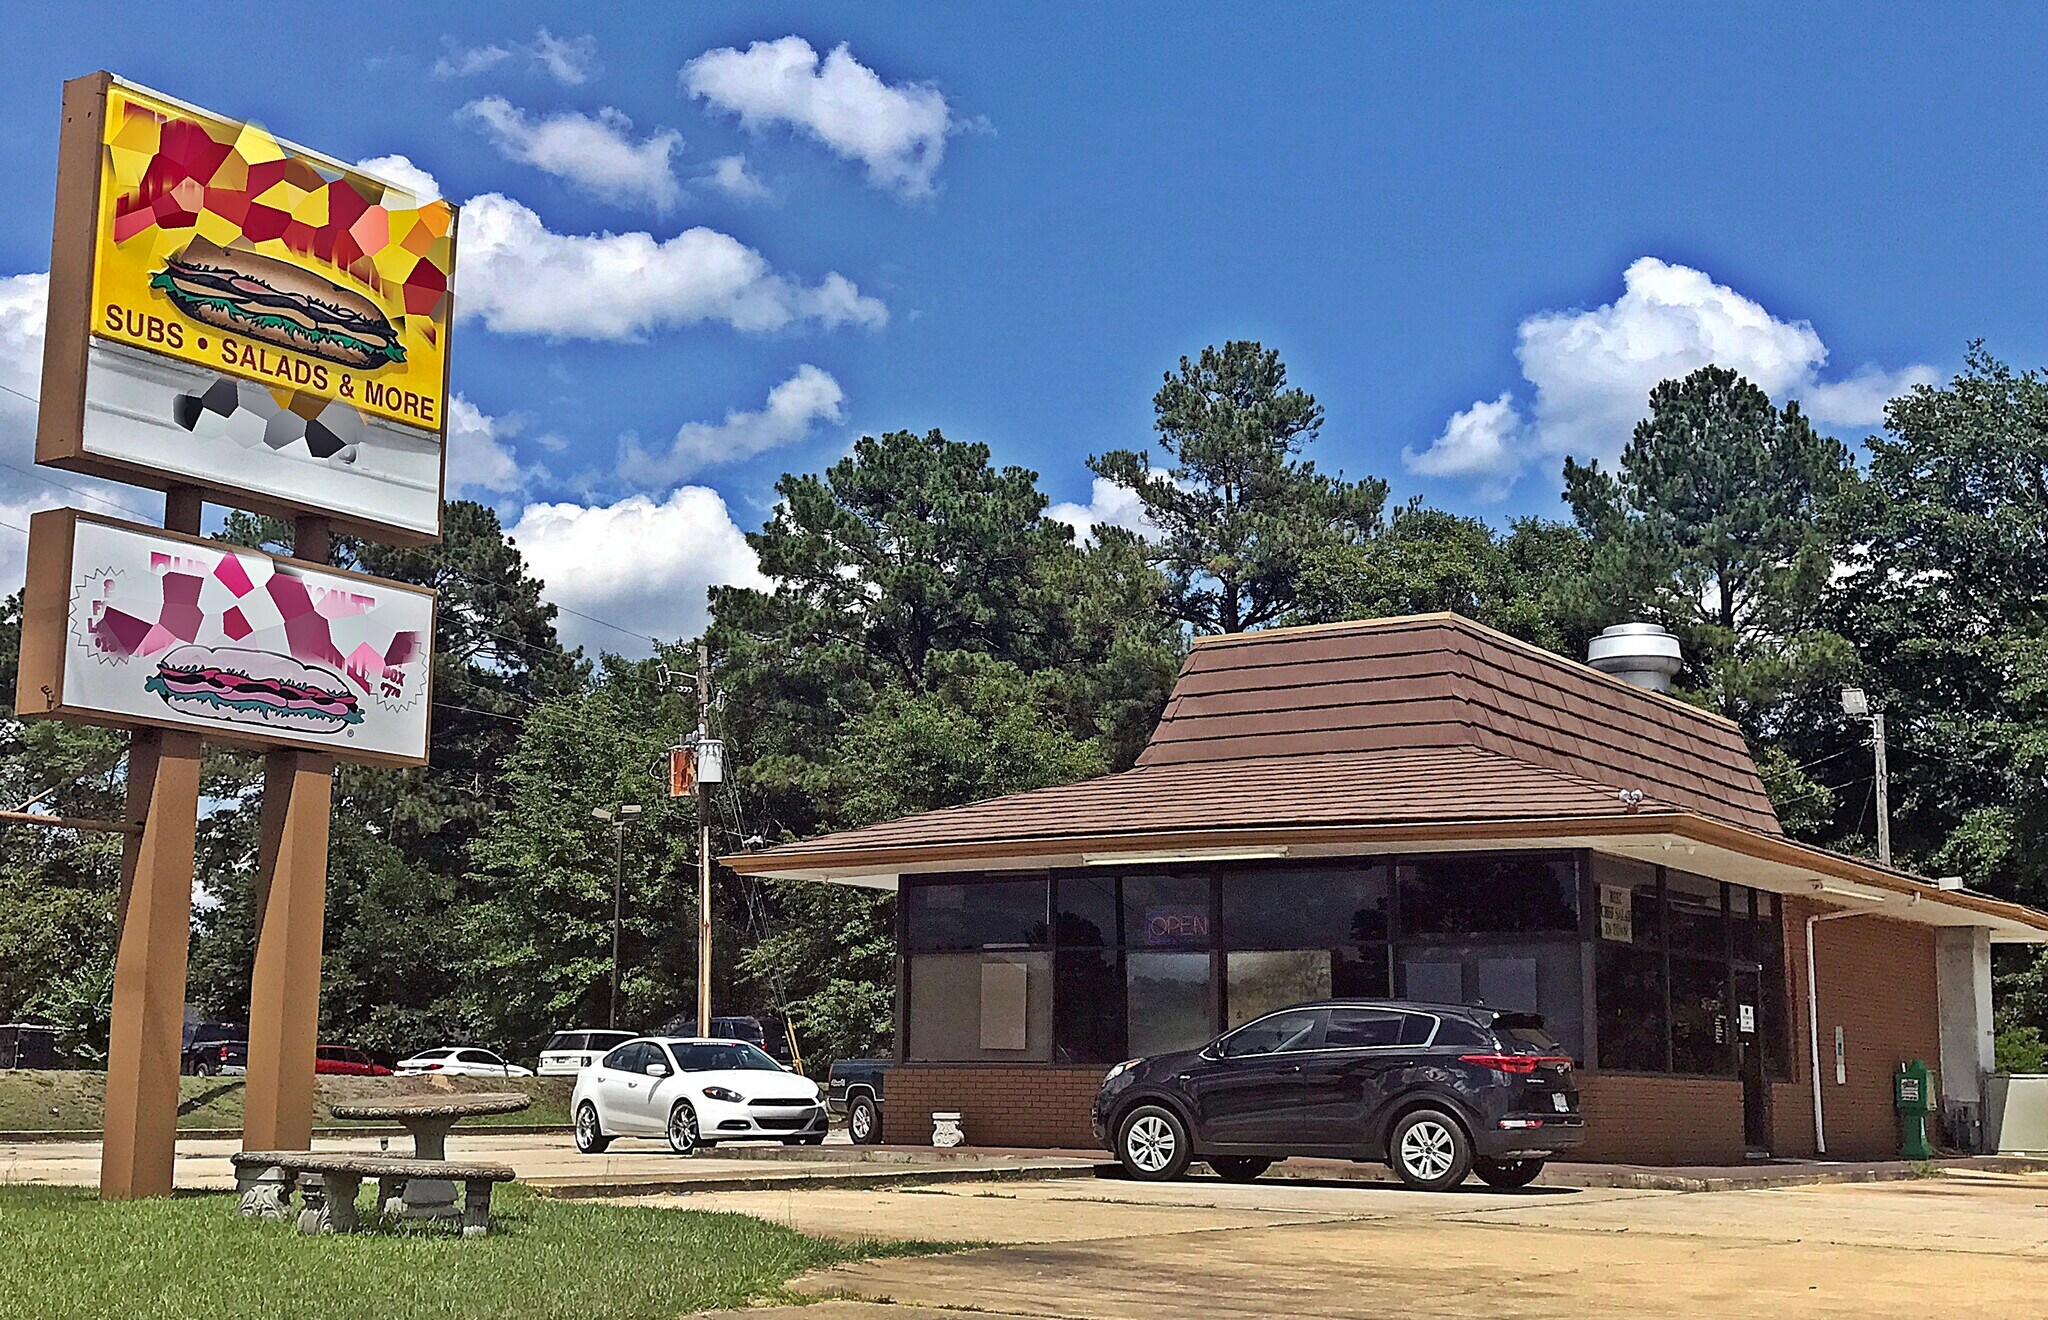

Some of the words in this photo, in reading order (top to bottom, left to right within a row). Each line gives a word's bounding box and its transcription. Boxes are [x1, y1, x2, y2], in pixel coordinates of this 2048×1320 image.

[106, 304, 184, 349] SUBS
[221, 338, 328, 391] SALADS
[339, 374, 355, 398] &
[365, 380, 435, 422] MORE
[1152, 916, 1207, 936] OPEN
